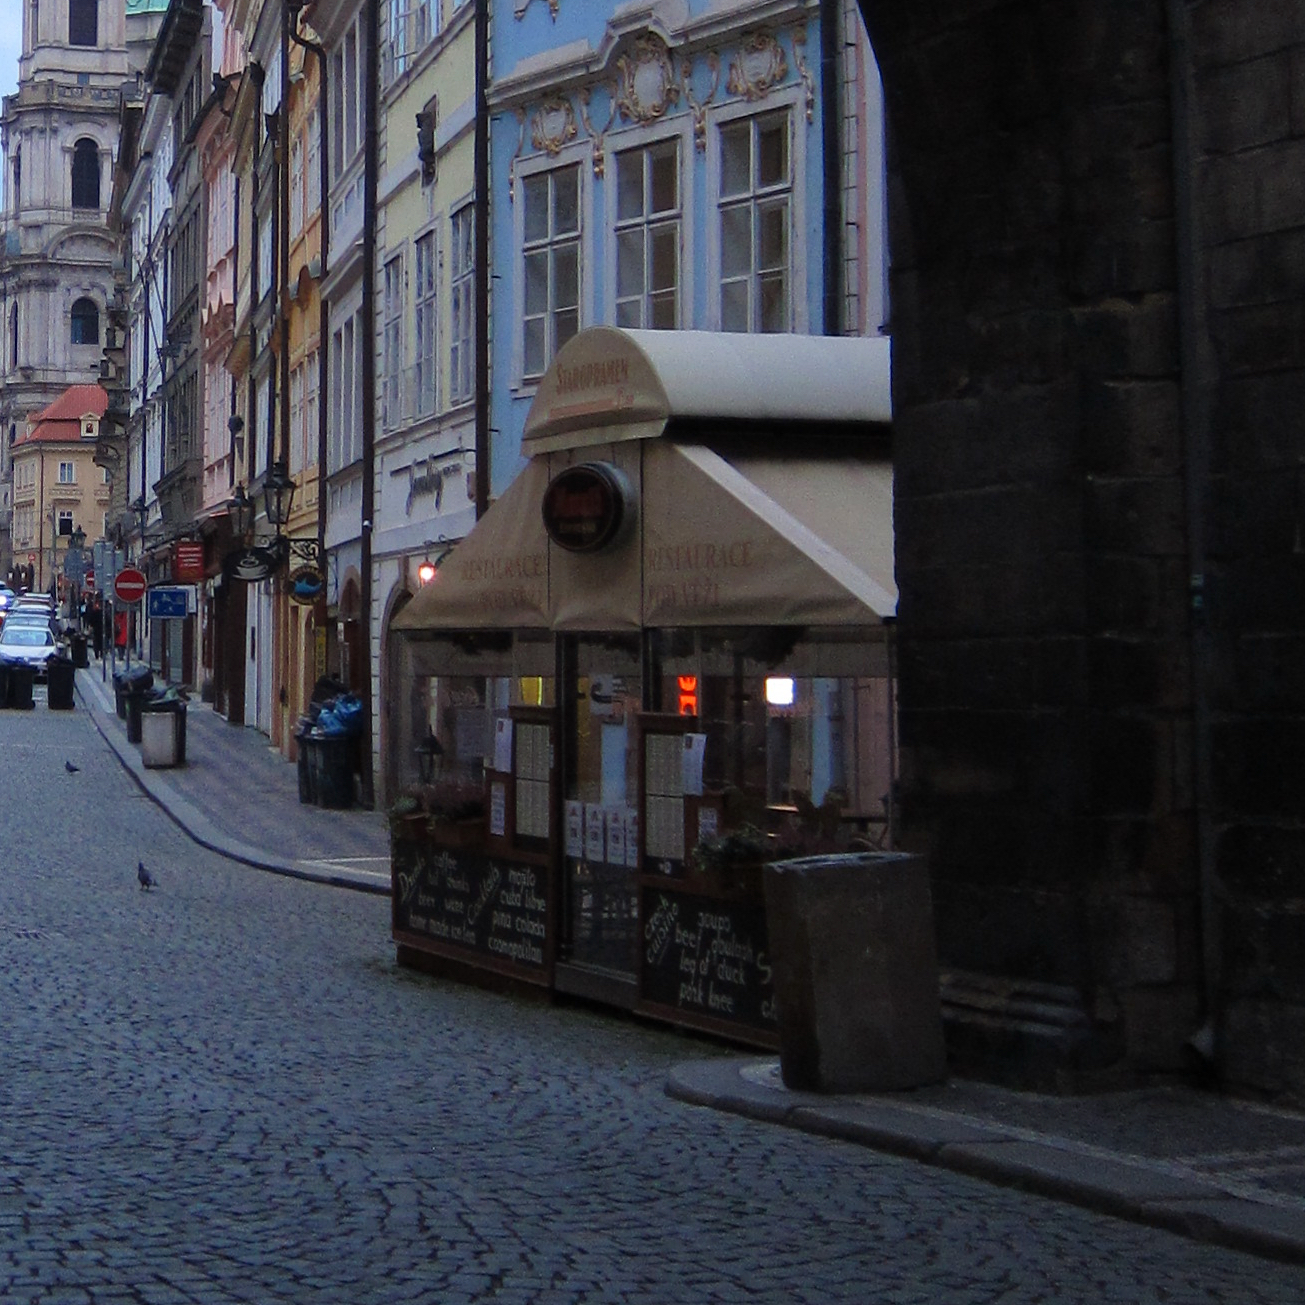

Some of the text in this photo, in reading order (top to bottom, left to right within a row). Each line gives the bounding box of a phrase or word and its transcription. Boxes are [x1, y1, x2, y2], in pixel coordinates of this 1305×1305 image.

[555, 358, 629, 396] STAROPRAMEN
[647, 540, 753, 571] RESTAURACE
[508, 867, 536, 894] mojito
[488, 936, 543, 964] cosmopolitan
